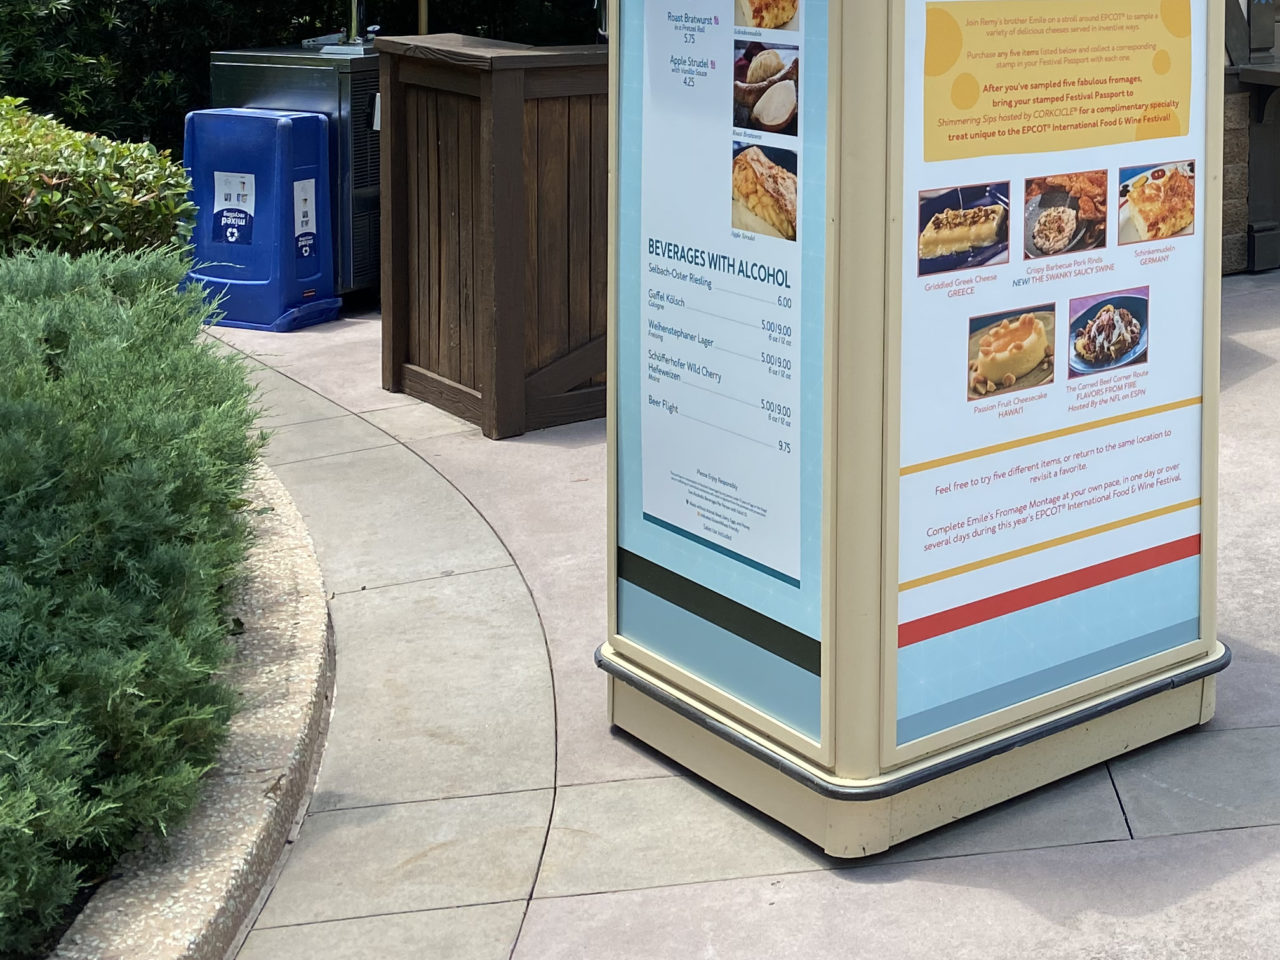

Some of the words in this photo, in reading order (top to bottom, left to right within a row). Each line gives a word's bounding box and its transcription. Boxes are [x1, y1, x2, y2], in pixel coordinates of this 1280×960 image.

[667, 11, 684, 23] Roast
[684, 12, 713, 25] Bratwurst
[684, 34, 696, 44] 5.75
[670, 55, 687, 69] Apple
[687, 56, 709, 69] Strudel
[683, 78, 695, 87] 4.25
[982, 83, 1003, 92] After
[1004, 82, 1028, 93] you've
[1029, 79, 1061, 90] sampled
[1062, 78, 1075, 86] five
[1077, 77, 1107, 86] fabulous
[1108, 75, 1142, 84] fromages,
[992, 99, 1012, 108] bring
[1013, 98, 1030, 107] your
[1032, 94, 1064, 104] stamped
[1065, 92, 1093, 101] Festival
[1094, 90, 1125, 99] Passport
[937, 117, 981, 127] Shimmering
[981, 113, 997, 124] Sips
[998, 111, 1022, 121] hosted
[1023, 111, 1032, 121] by
[1078, 106, 1089, 114] for
[1095, 103, 1148, 113] complimentary
[1149, 99, 1179, 110] specialty
[948, 132, 968, 141] treat
[969, 130, 996, 140] unique
[1007, 127, 1021, 135] the
[1052, 119, 1099, 131] International
[1099, 118, 1116, 127] Food
[1116, 117, 1123, 126] &
[1122, 115, 1141, 127] Wine
[1142, 113, 1170, 122] Festival!
[221, 217, 246, 227] mixed
[648, 238, 706, 267] BEVERAGES
[707, 252, 735, 275] WITH
[737, 259, 791, 289] ALCOHOL
[1026, 263, 1045, 274] Crispy
[1045, 262, 1072, 271] Barbecue
[1073, 258, 1087, 268] Pork
[1087, 254, 1104, 267] Rinds
[1139, 255, 1170, 265] GERMANY
[924, 279, 953, 291] Griddled
[954, 277, 973, 286] Greek
[974, 274, 997, 283] Cheese
[1012, 277, 1031, 286] NEW!
[1031, 273, 1044, 284] THE
[1044, 270, 1073, 283] SWANKY
[1074, 267, 1095, 278] SAUCY
[1095, 265, 1115, 274] SWINE
[648, 262, 688, 281] Selbach-Oster
[689, 272, 712, 290] Riesling
[777, 296, 792, 309] 6.00
[947, 286, 975, 297] GREECE
[648, 289, 665, 302] Gaffel
[666, 294, 685, 307] Kölsch
[697, 333, 714, 349] Lager
[648, 364, 681, 381] Hefeweizen
[686, 361, 700, 374] Wild
[701, 365, 722, 385] Cherry
[1067, 401, 1089, 411] Hosted
[1109, 393, 1120, 402] NFL
[1130, 388, 1147, 399] ESPN
[1075, 385, 1104, 400] FLAVORS
[1105, 385, 1123, 395] FROM
[1123, 380, 1137, 391] FIRE
[973, 404, 996, 413] Passion
[997, 399, 1011, 408] Fruit
[1012, 392, 1047, 405] Cheesecake
[648, 394, 662, 408] Beer
[662, 399, 679, 415] Flight
[778, 440, 792, 454] 9.75
[935, 483, 951, 495] Feel
[953, 481, 968, 490] free
[970, 478, 979, 486] to
[980, 475, 991, 485] try
[993, 470, 1006, 480] five
[1006, 462, 1039, 476] different
[1040, 457, 1061, 467] items,
[1072, 449, 1094, 459] return
[1104, 443, 1116, 451] the
[1117, 439, 1135, 448] same
[1136, 431, 1163, 443] location
[1164, 429, 1171, 437] to
[1029, 471, 1051, 482] revisit
[1059, 463, 1086, 475] favorite.
[926, 521, 965, 537] Complete
[966, 511, 993, 526] Emile's
[995, 504, 1027, 518] Fromage
[1028, 495, 1060, 508] Montage
[1062, 491, 1069, 500] at
[1070, 487, 1086, 500] your
[1087, 483, 1102, 493] own
[1103, 479, 1121, 491] pace,
[1129, 473, 1142, 481] one
[1143, 469, 1155, 478] day
[1165, 463, 1179, 472] over
[923, 535, 951, 551] several
[952, 532, 970, 543] days
[971, 525, 996, 537] during
[996, 520, 1011, 531] this
[1013, 515, 1033, 528] year's
[1067, 491, 1111, 510] International
[1112, 486, 1129, 498] Food
[1130, 485, 1136, 493] &
[1137, 482, 1154, 491] Wine
[1154, 473, 1181, 486] Festival.
